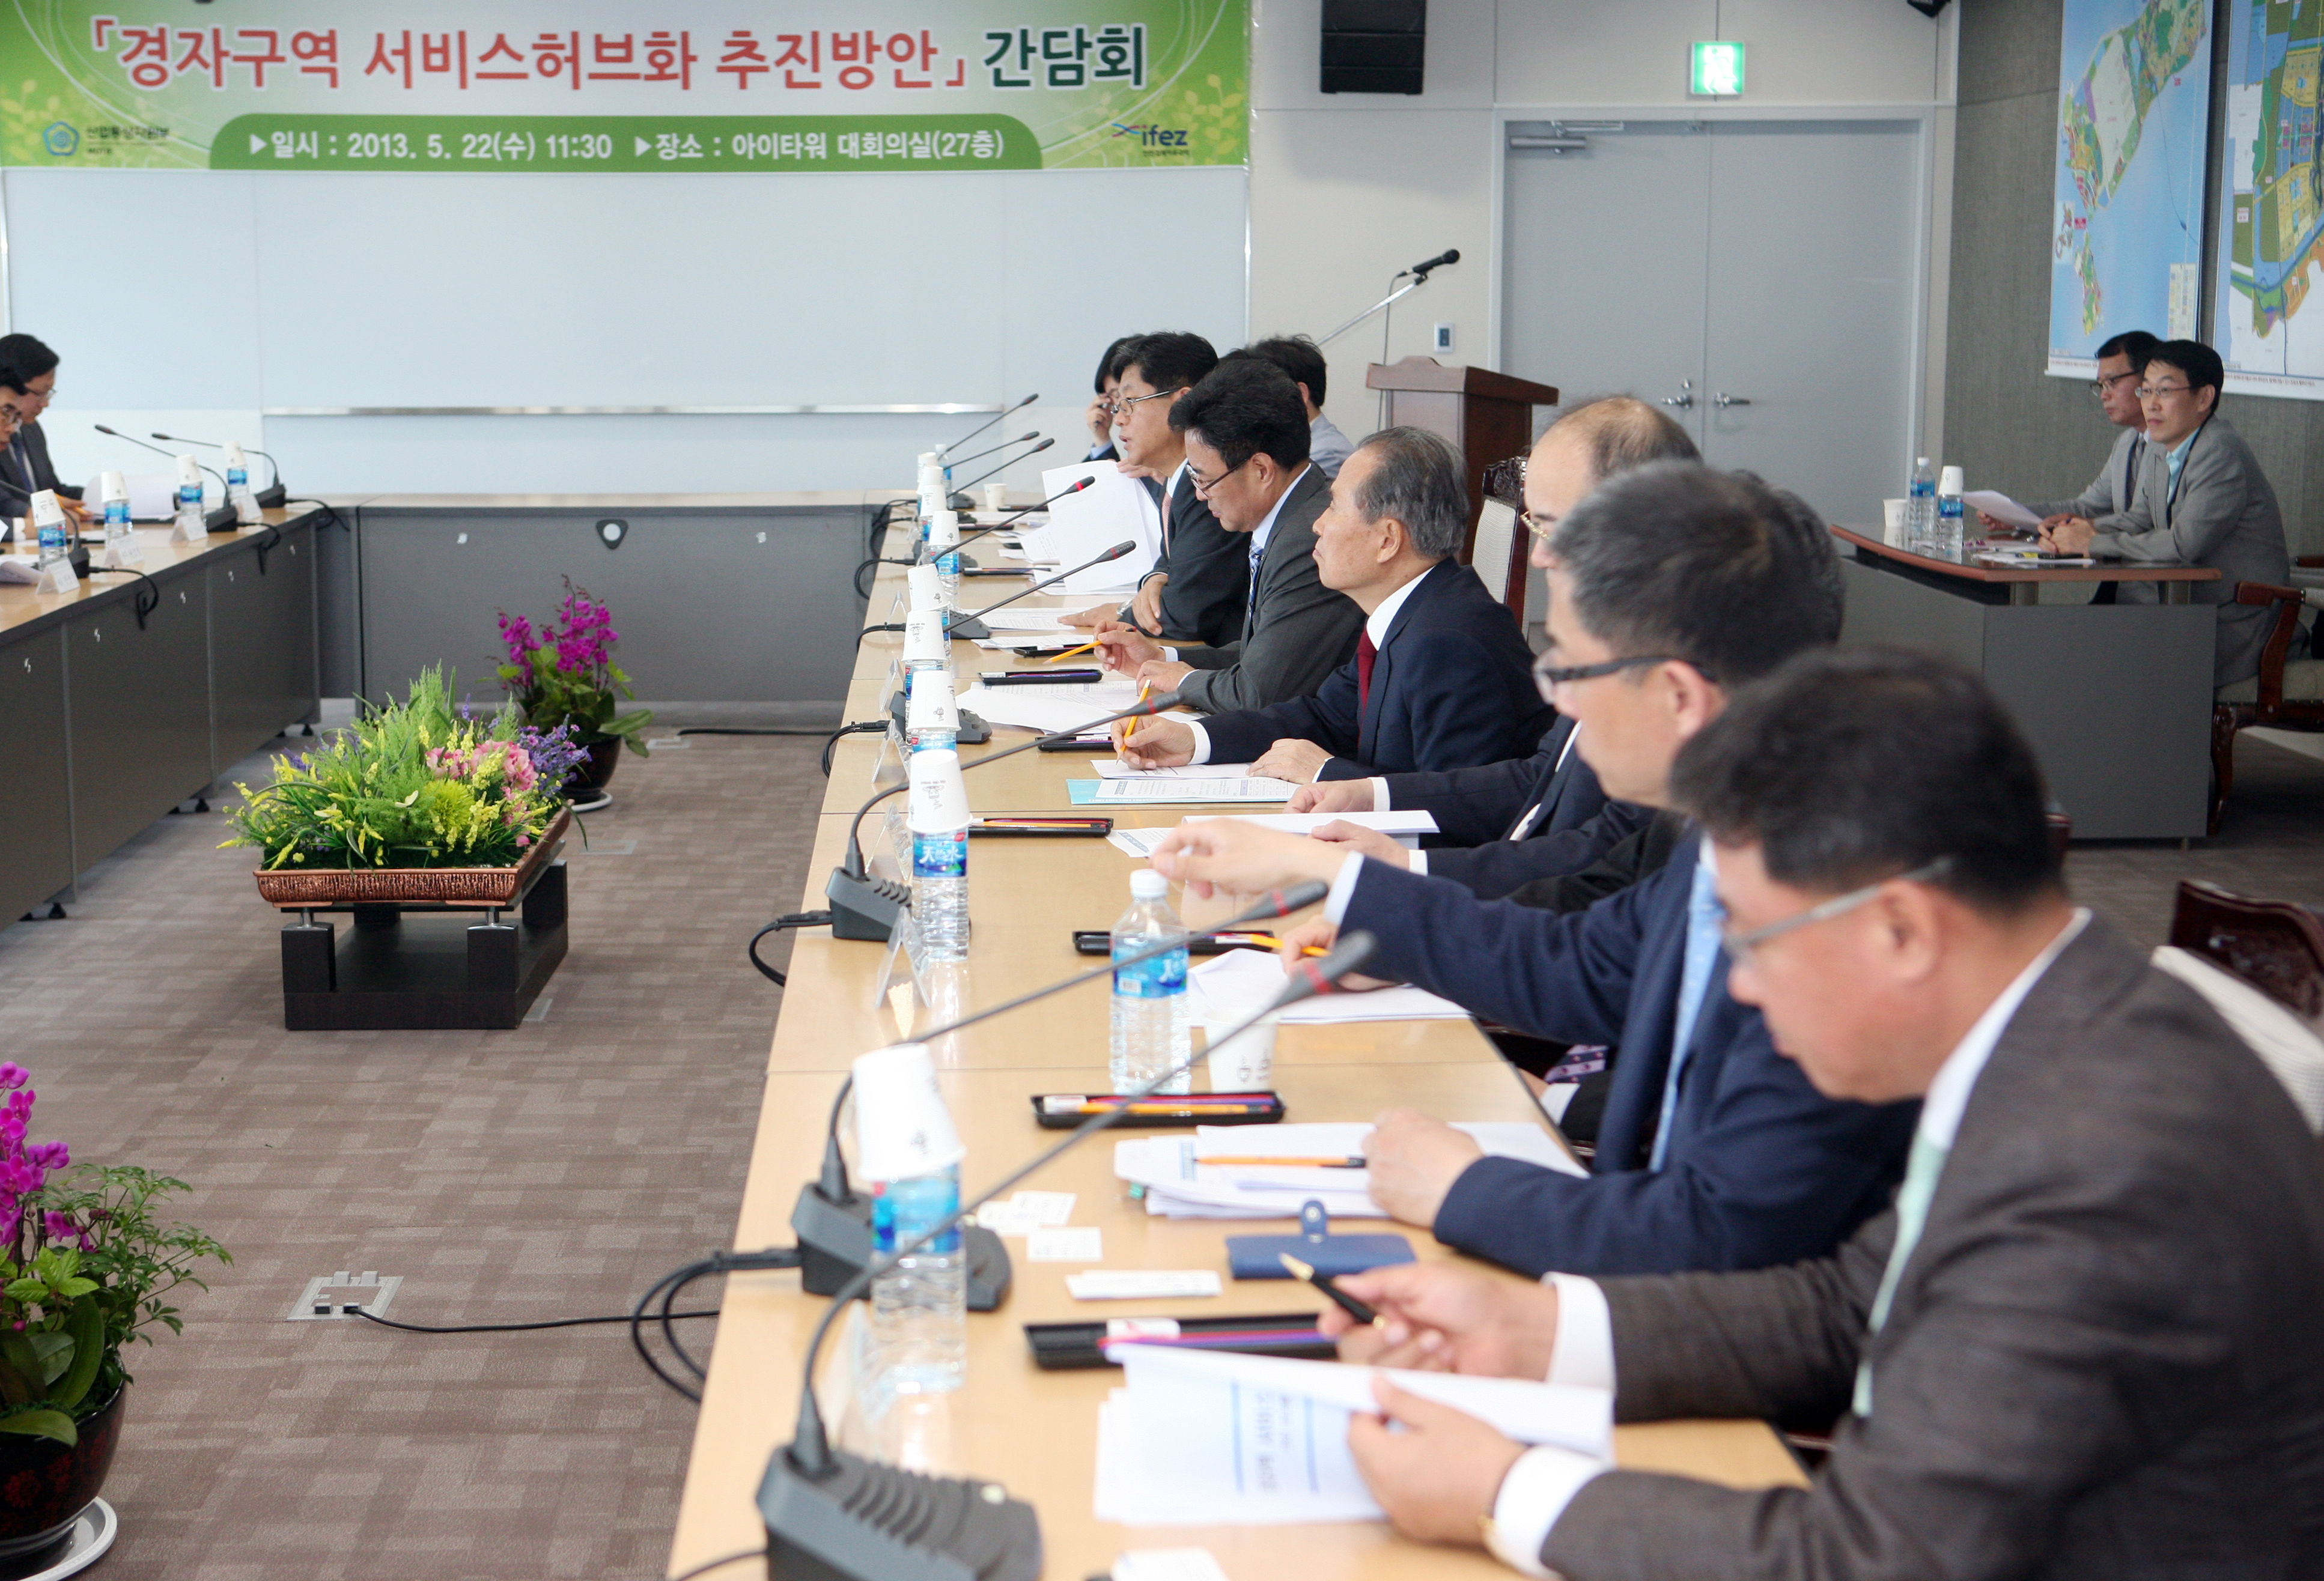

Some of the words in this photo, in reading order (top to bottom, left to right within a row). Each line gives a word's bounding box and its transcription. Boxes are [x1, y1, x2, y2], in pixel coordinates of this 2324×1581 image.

[365, 31, 698, 90] 서비스허브화
[717, 30, 964, 90] 추진방안」
[985, 27, 1143, 87] 간담회
[272, 131, 319, 159] 일시
[347, 132, 417, 159] 2013.
[428, 134, 452, 159] 5.
[462, 132, 535, 161] 22(수)
[546, 134, 613, 159] 11:30
[656, 133, 704, 160] 장소
[732, 132, 827, 160] 아이타워
[838, 130, 1003, 160] 대회의실(27층)
[1142, 124, 1188, 146] ifez
